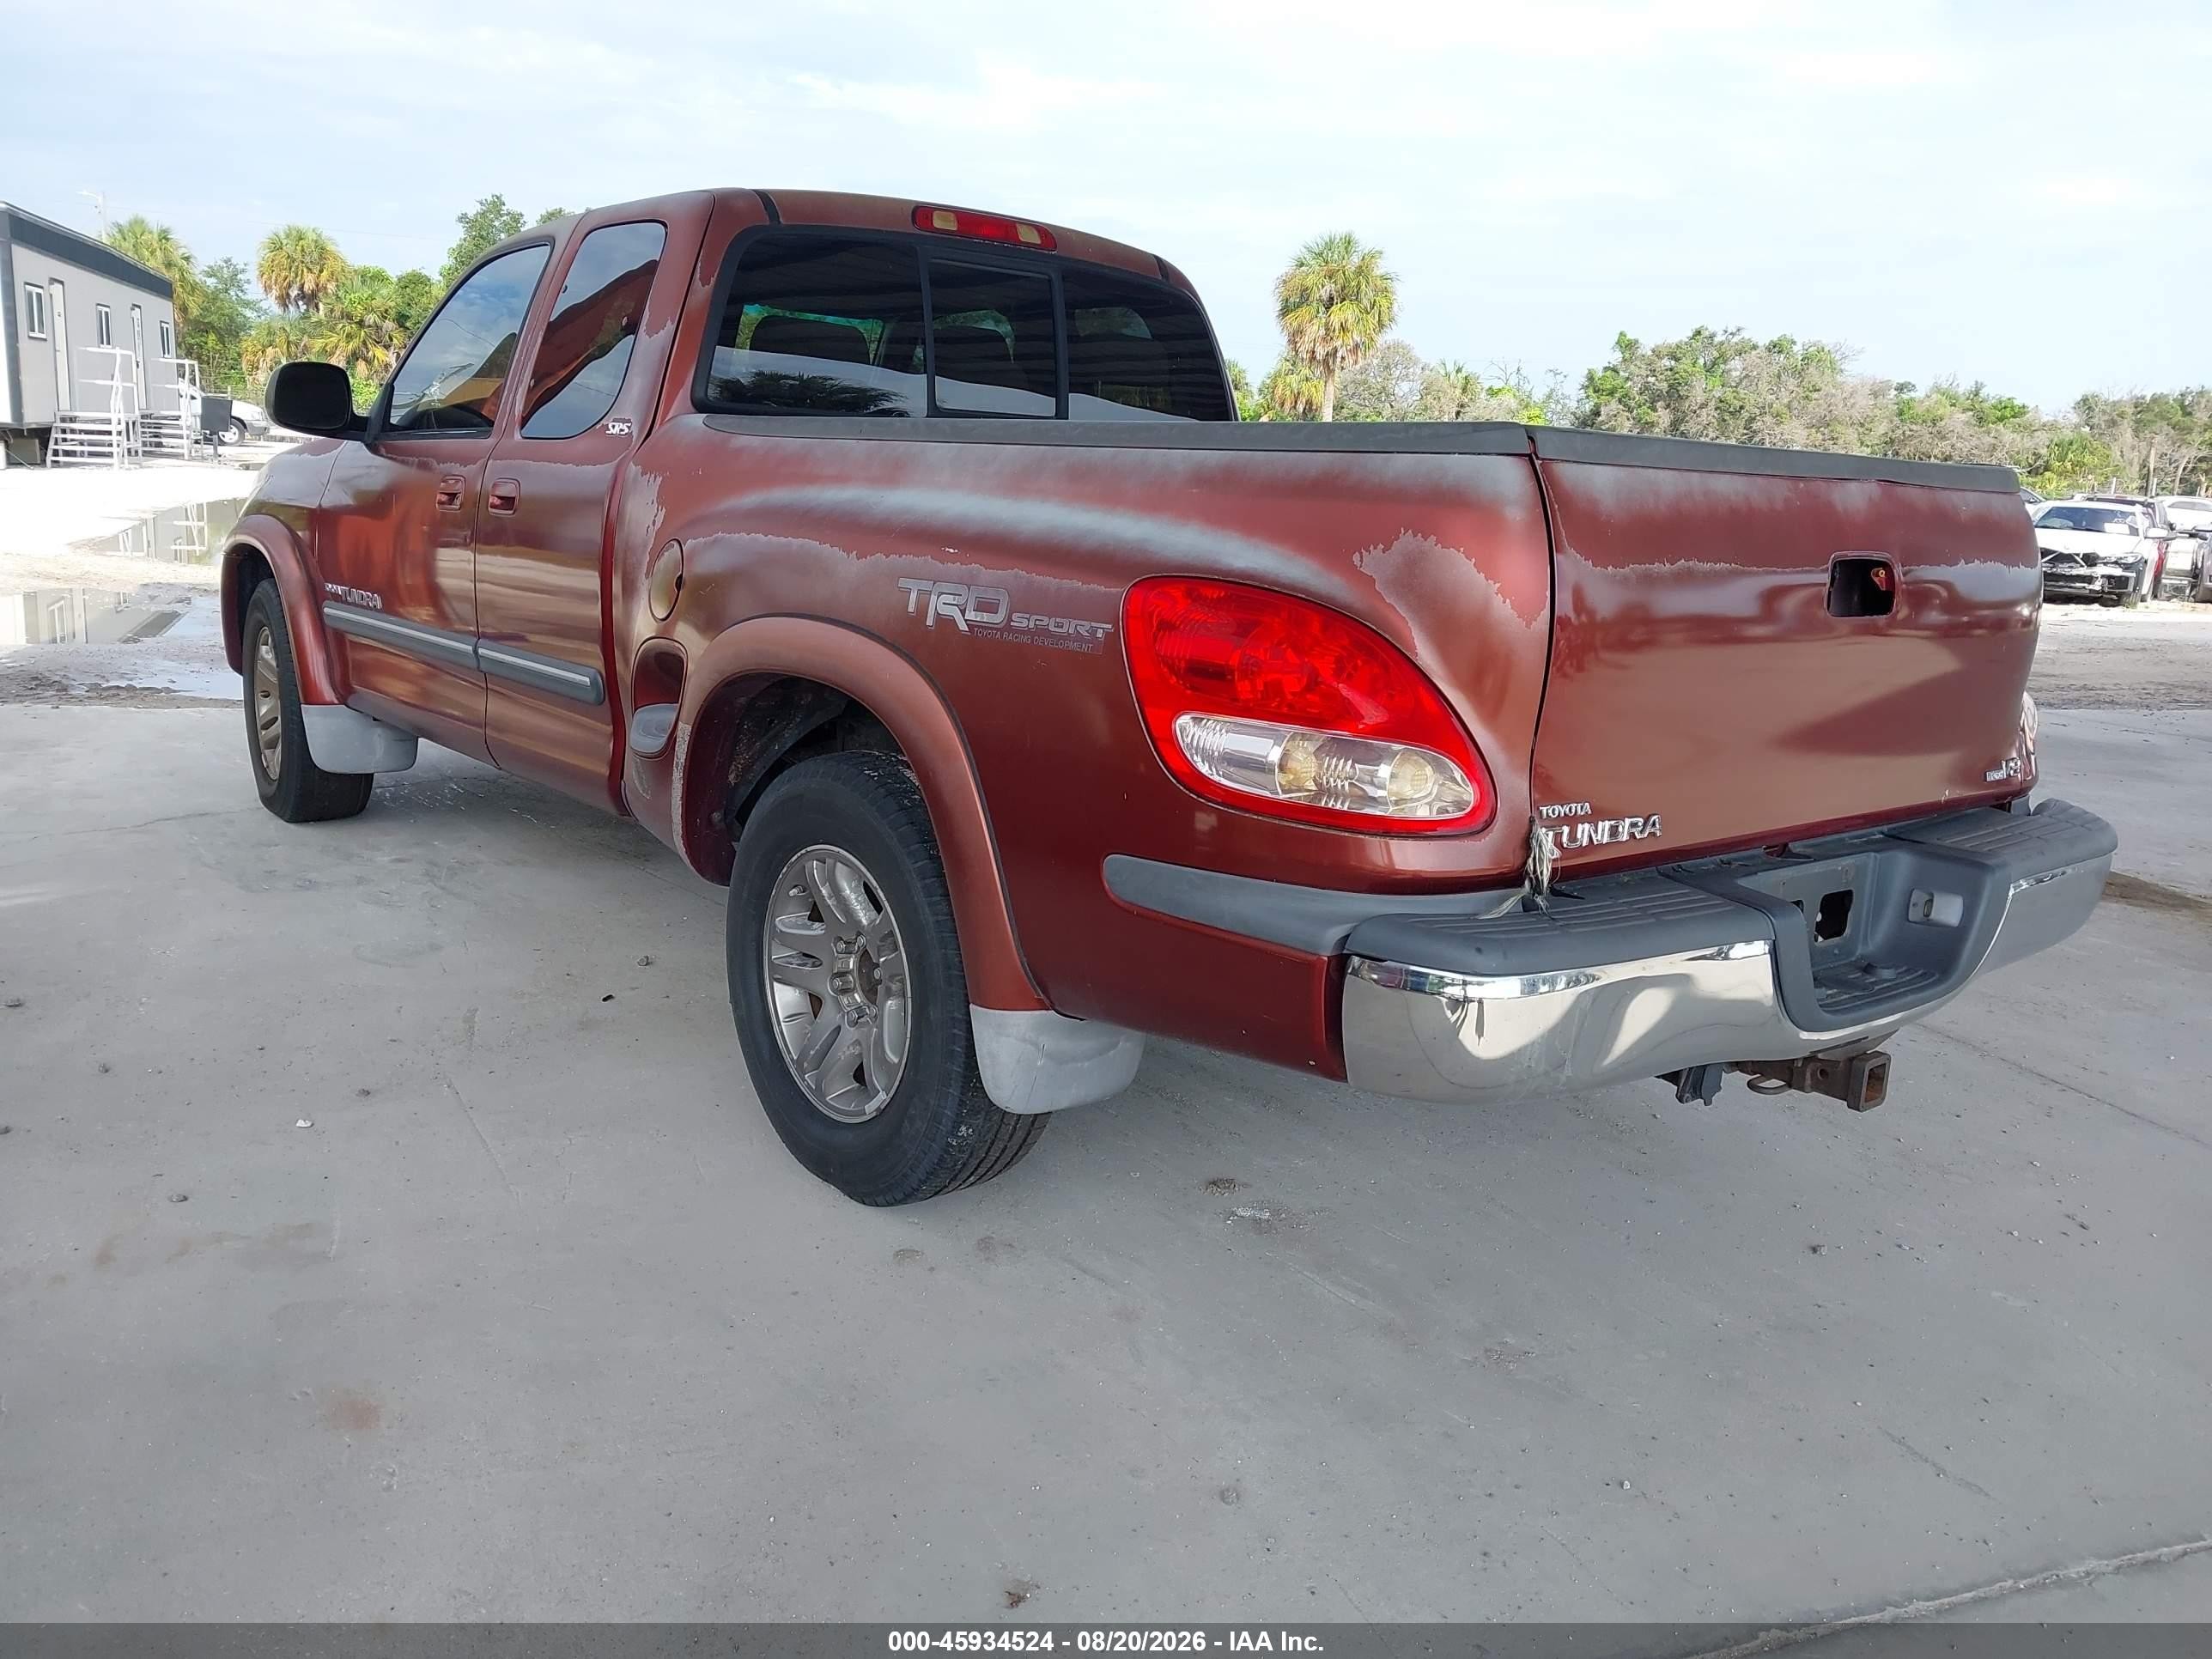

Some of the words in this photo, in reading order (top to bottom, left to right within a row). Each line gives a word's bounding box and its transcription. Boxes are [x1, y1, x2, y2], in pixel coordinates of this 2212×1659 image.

[341, 586, 383, 610] TUNDRA
[898, 577, 1010, 633] TRD
[1011, 612, 1115, 640] SPORT
[974, 628, 1001, 640] TOYOTA
[1003, 631, 1031, 644] RACING
[1034, 636, 1094, 653] DEVELOPMENT
[1540, 802, 1592, 818] TOYOTA
[1542, 814, 1662, 850] TUNDRA
